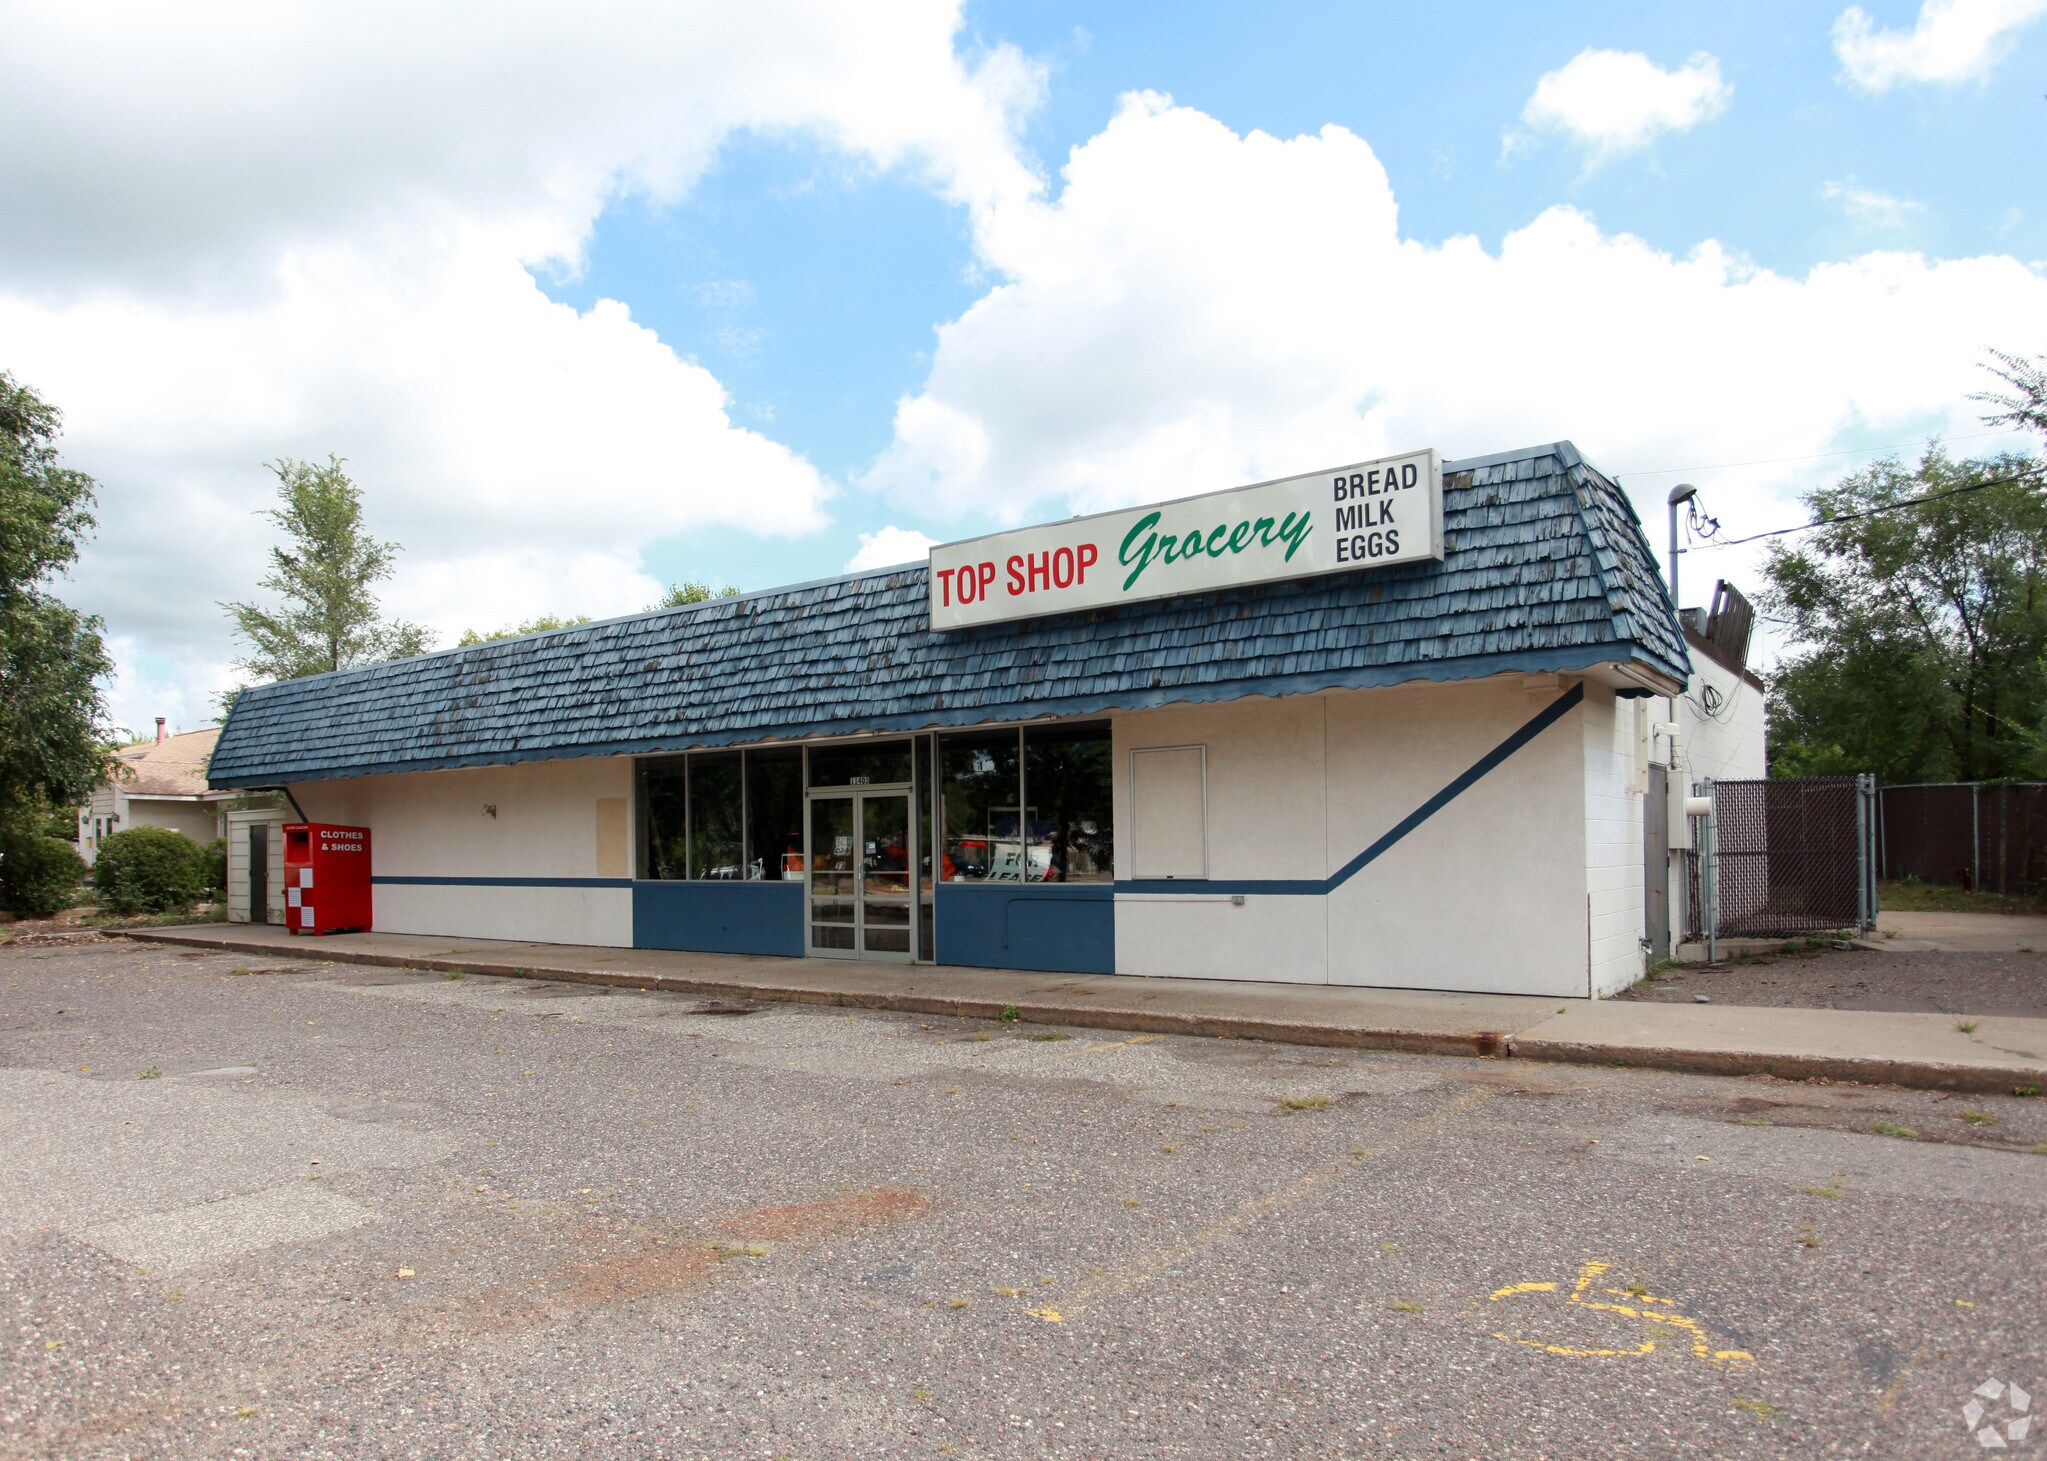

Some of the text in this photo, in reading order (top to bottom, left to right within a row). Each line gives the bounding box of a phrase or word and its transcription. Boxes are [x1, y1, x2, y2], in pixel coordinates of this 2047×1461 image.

[1333, 463, 1418, 502] BREAD
[1335, 498, 1395, 532] MILK
[937, 511, 1313, 607] TOP SHOP Grocery
[1336, 530, 1400, 563] EGGS
[321, 831, 363, 839] CLOTHES
[331, 843, 362, 851] SHOES
